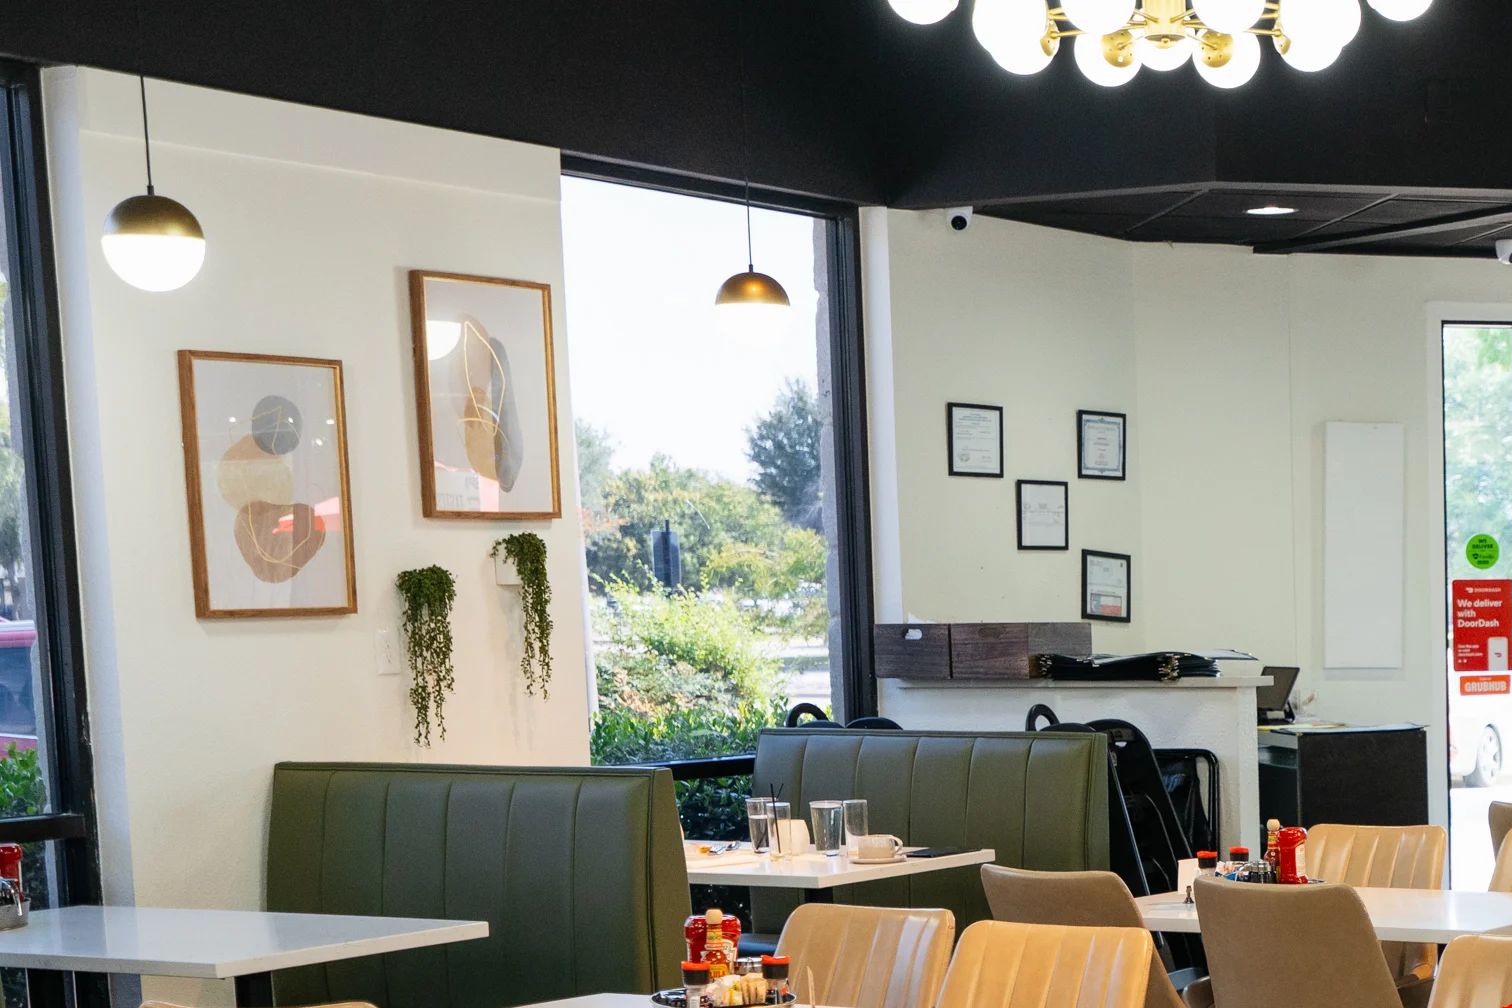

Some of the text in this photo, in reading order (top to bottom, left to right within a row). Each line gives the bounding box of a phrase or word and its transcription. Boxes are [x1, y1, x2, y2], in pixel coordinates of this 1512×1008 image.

[1473, 599, 1502, 607] deliver
[1457, 619, 1499, 628] DoorDash
[1464, 681, 1507, 692] GRUBHUB
